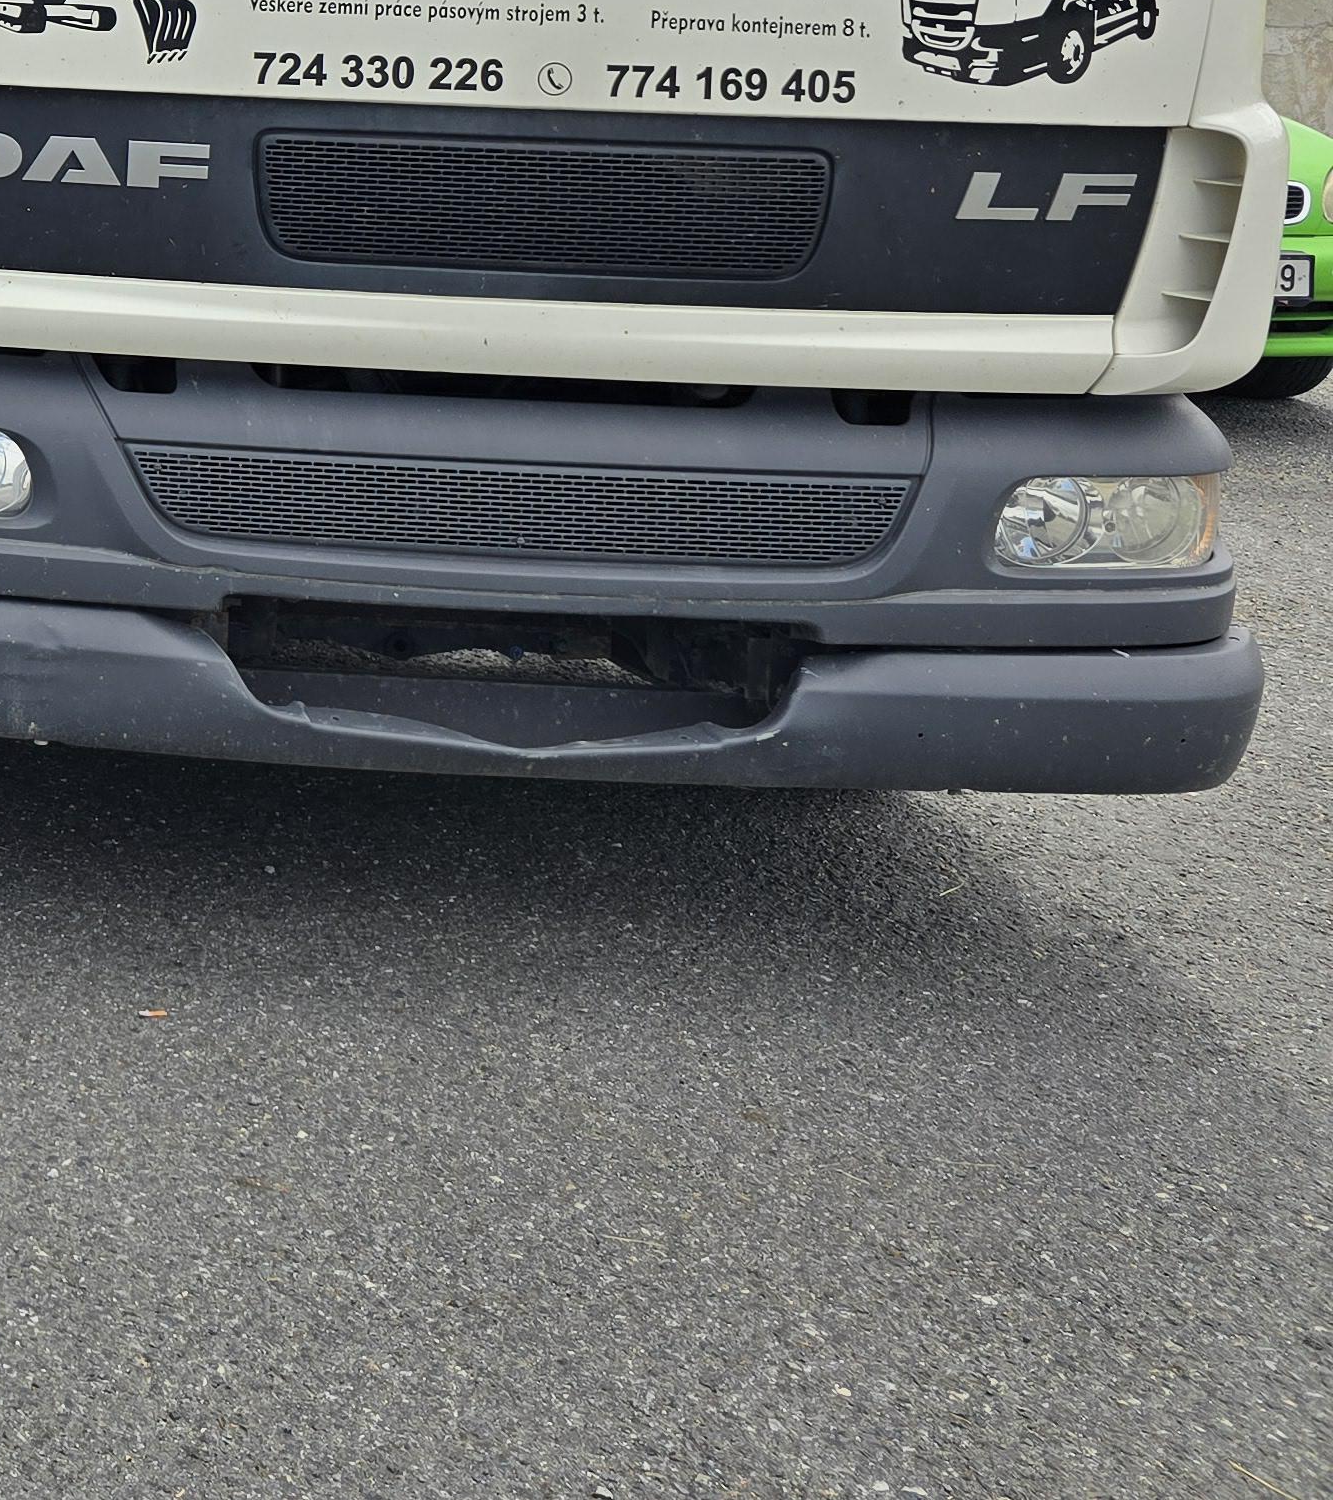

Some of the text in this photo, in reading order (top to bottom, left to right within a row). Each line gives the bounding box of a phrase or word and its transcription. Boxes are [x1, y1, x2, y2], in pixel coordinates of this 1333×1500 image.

[427, 0, 500, 26] pásovým
[506, 2, 570, 26] strojem
[576, 3, 587, 23] 3
[593, 7, 605, 24] t.
[650, 9, 871, 39] Přeprava kontejnerem 8 t.
[253, 51, 504, 92] 724 330 226
[606, 64, 856, 104] 774 169 405
[955, 171, 1138, 221] LF
[1275, 264, 1295, 292] 9
